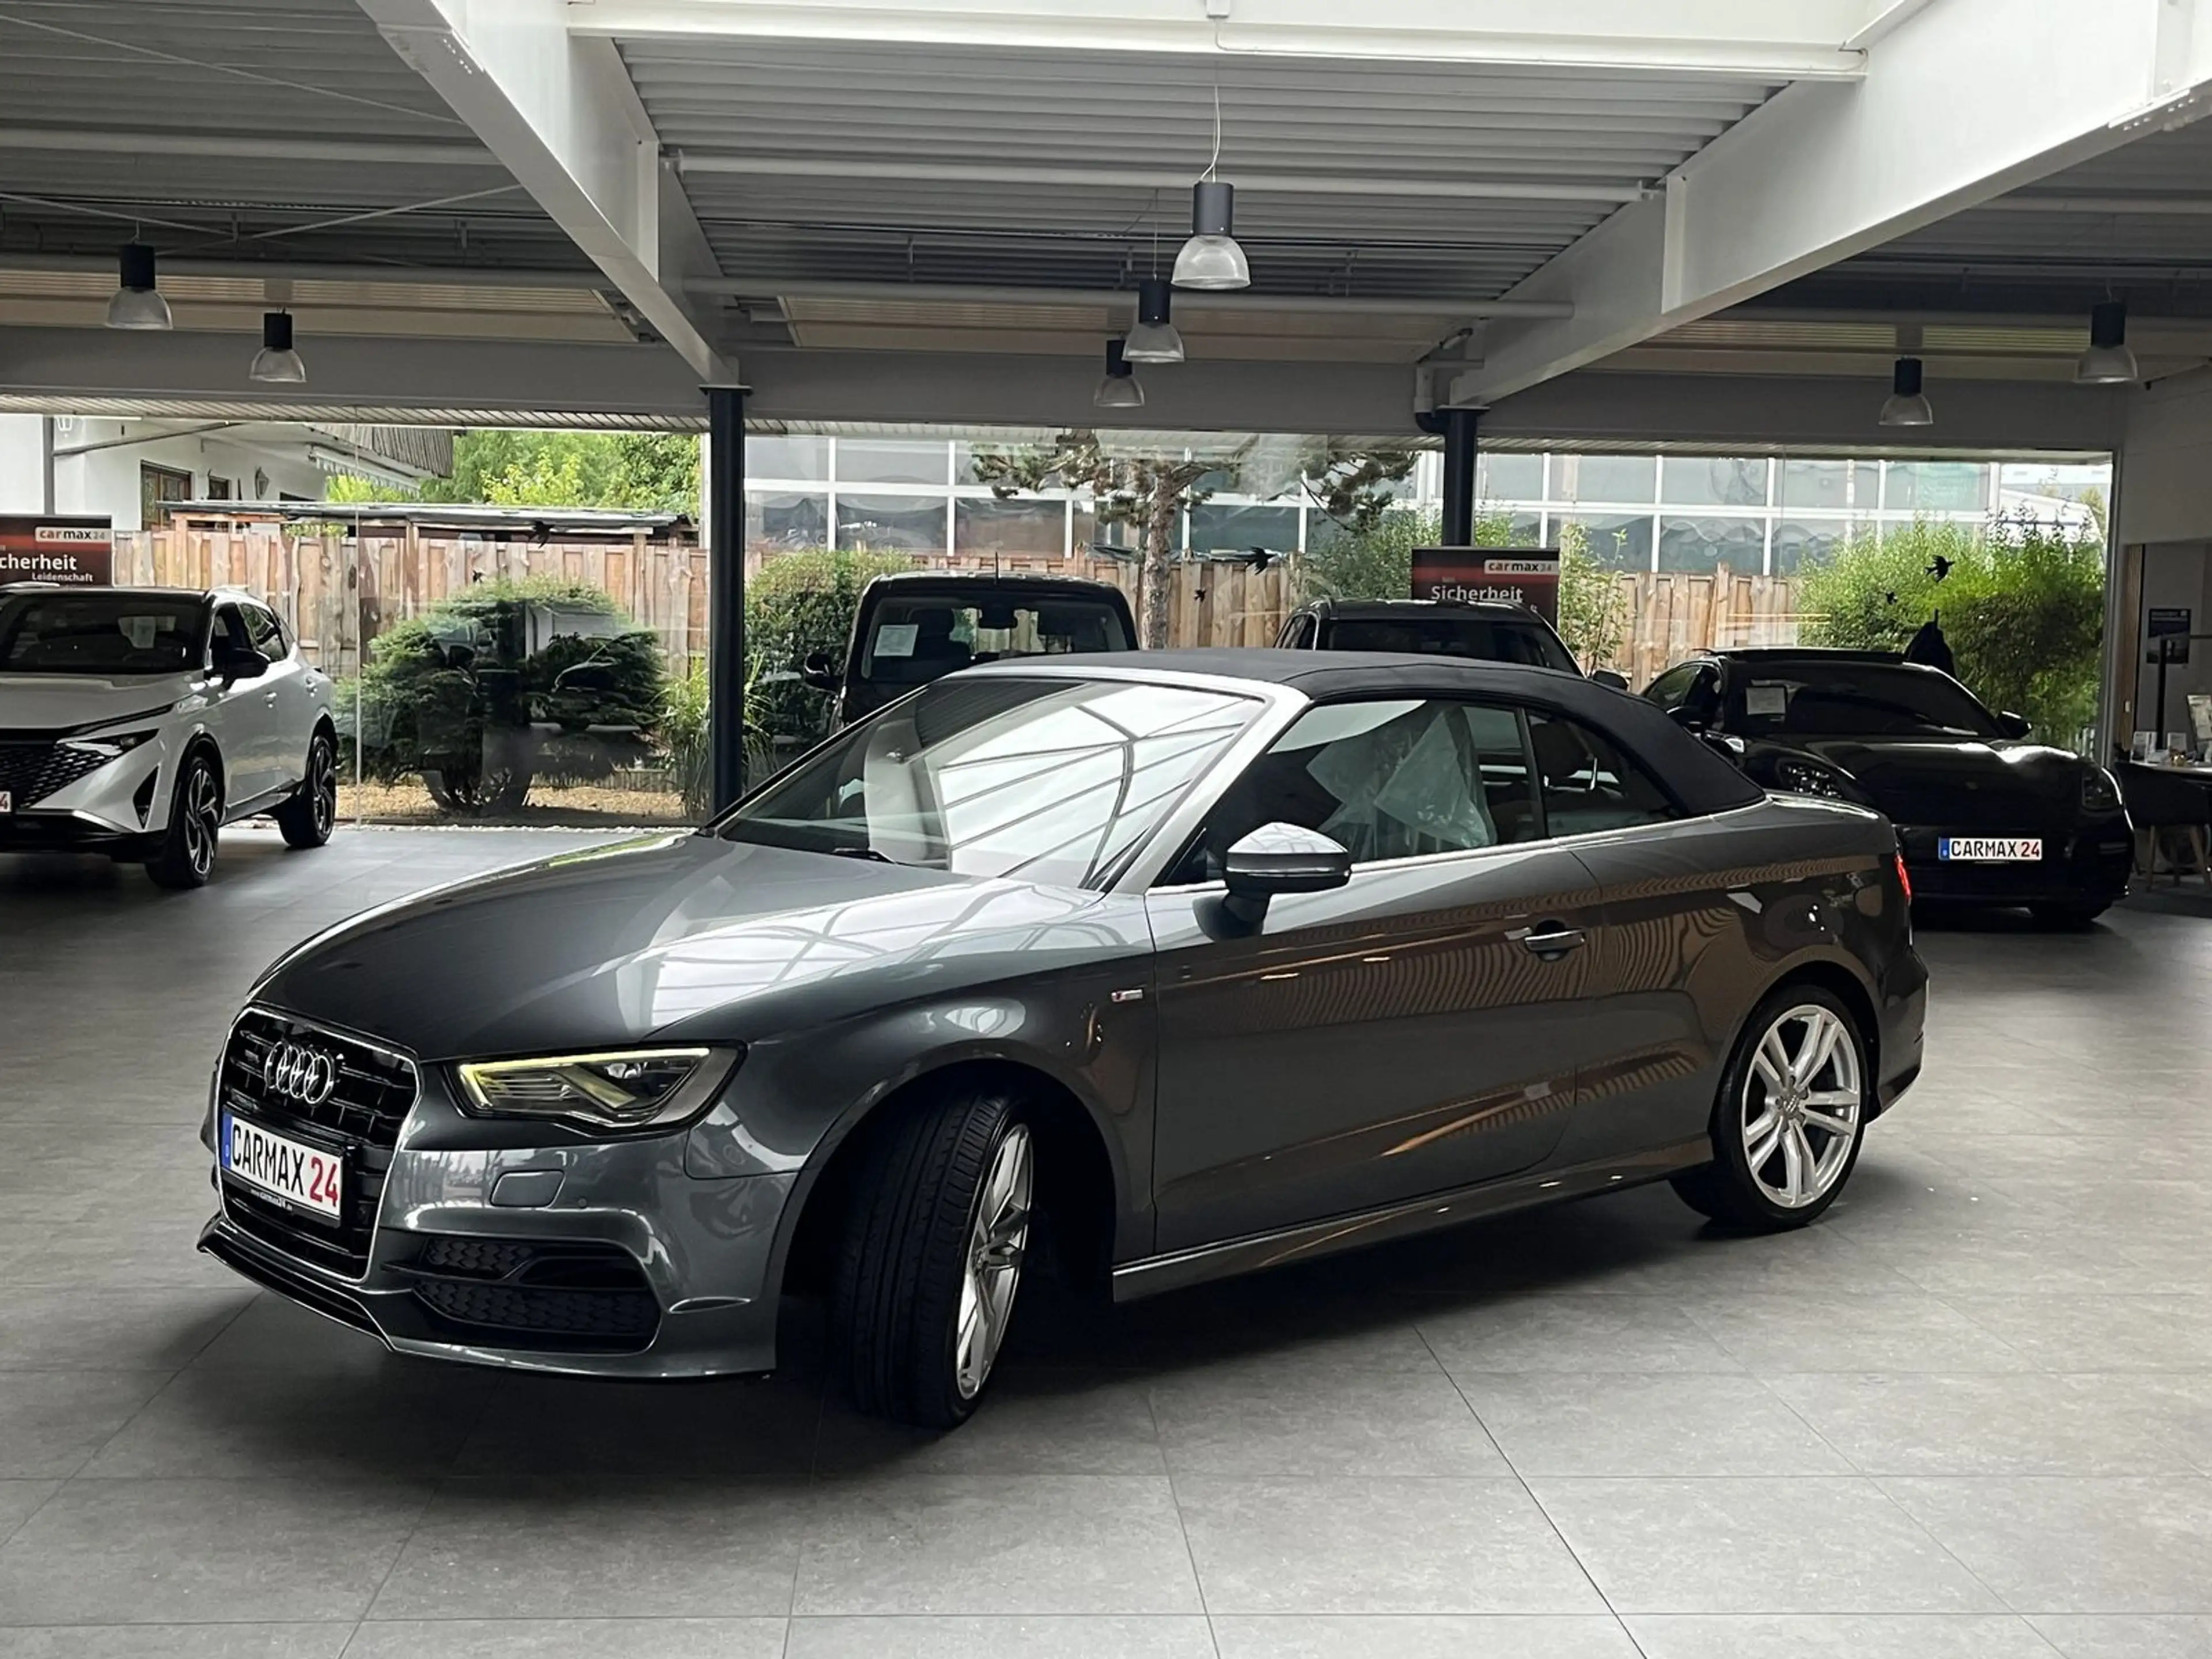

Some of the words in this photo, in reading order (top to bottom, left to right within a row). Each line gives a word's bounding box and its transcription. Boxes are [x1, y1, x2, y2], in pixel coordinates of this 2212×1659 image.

[32, 572, 93, 582] Leidenschaft
[1431, 585, 1523, 603] Sicherheit
[1951, 840, 2017, 857] CARMAX
[2021, 842, 2040, 857] 24
[232, 1124, 304, 1196] CARMAX
[309, 1157, 338, 1207] 24
